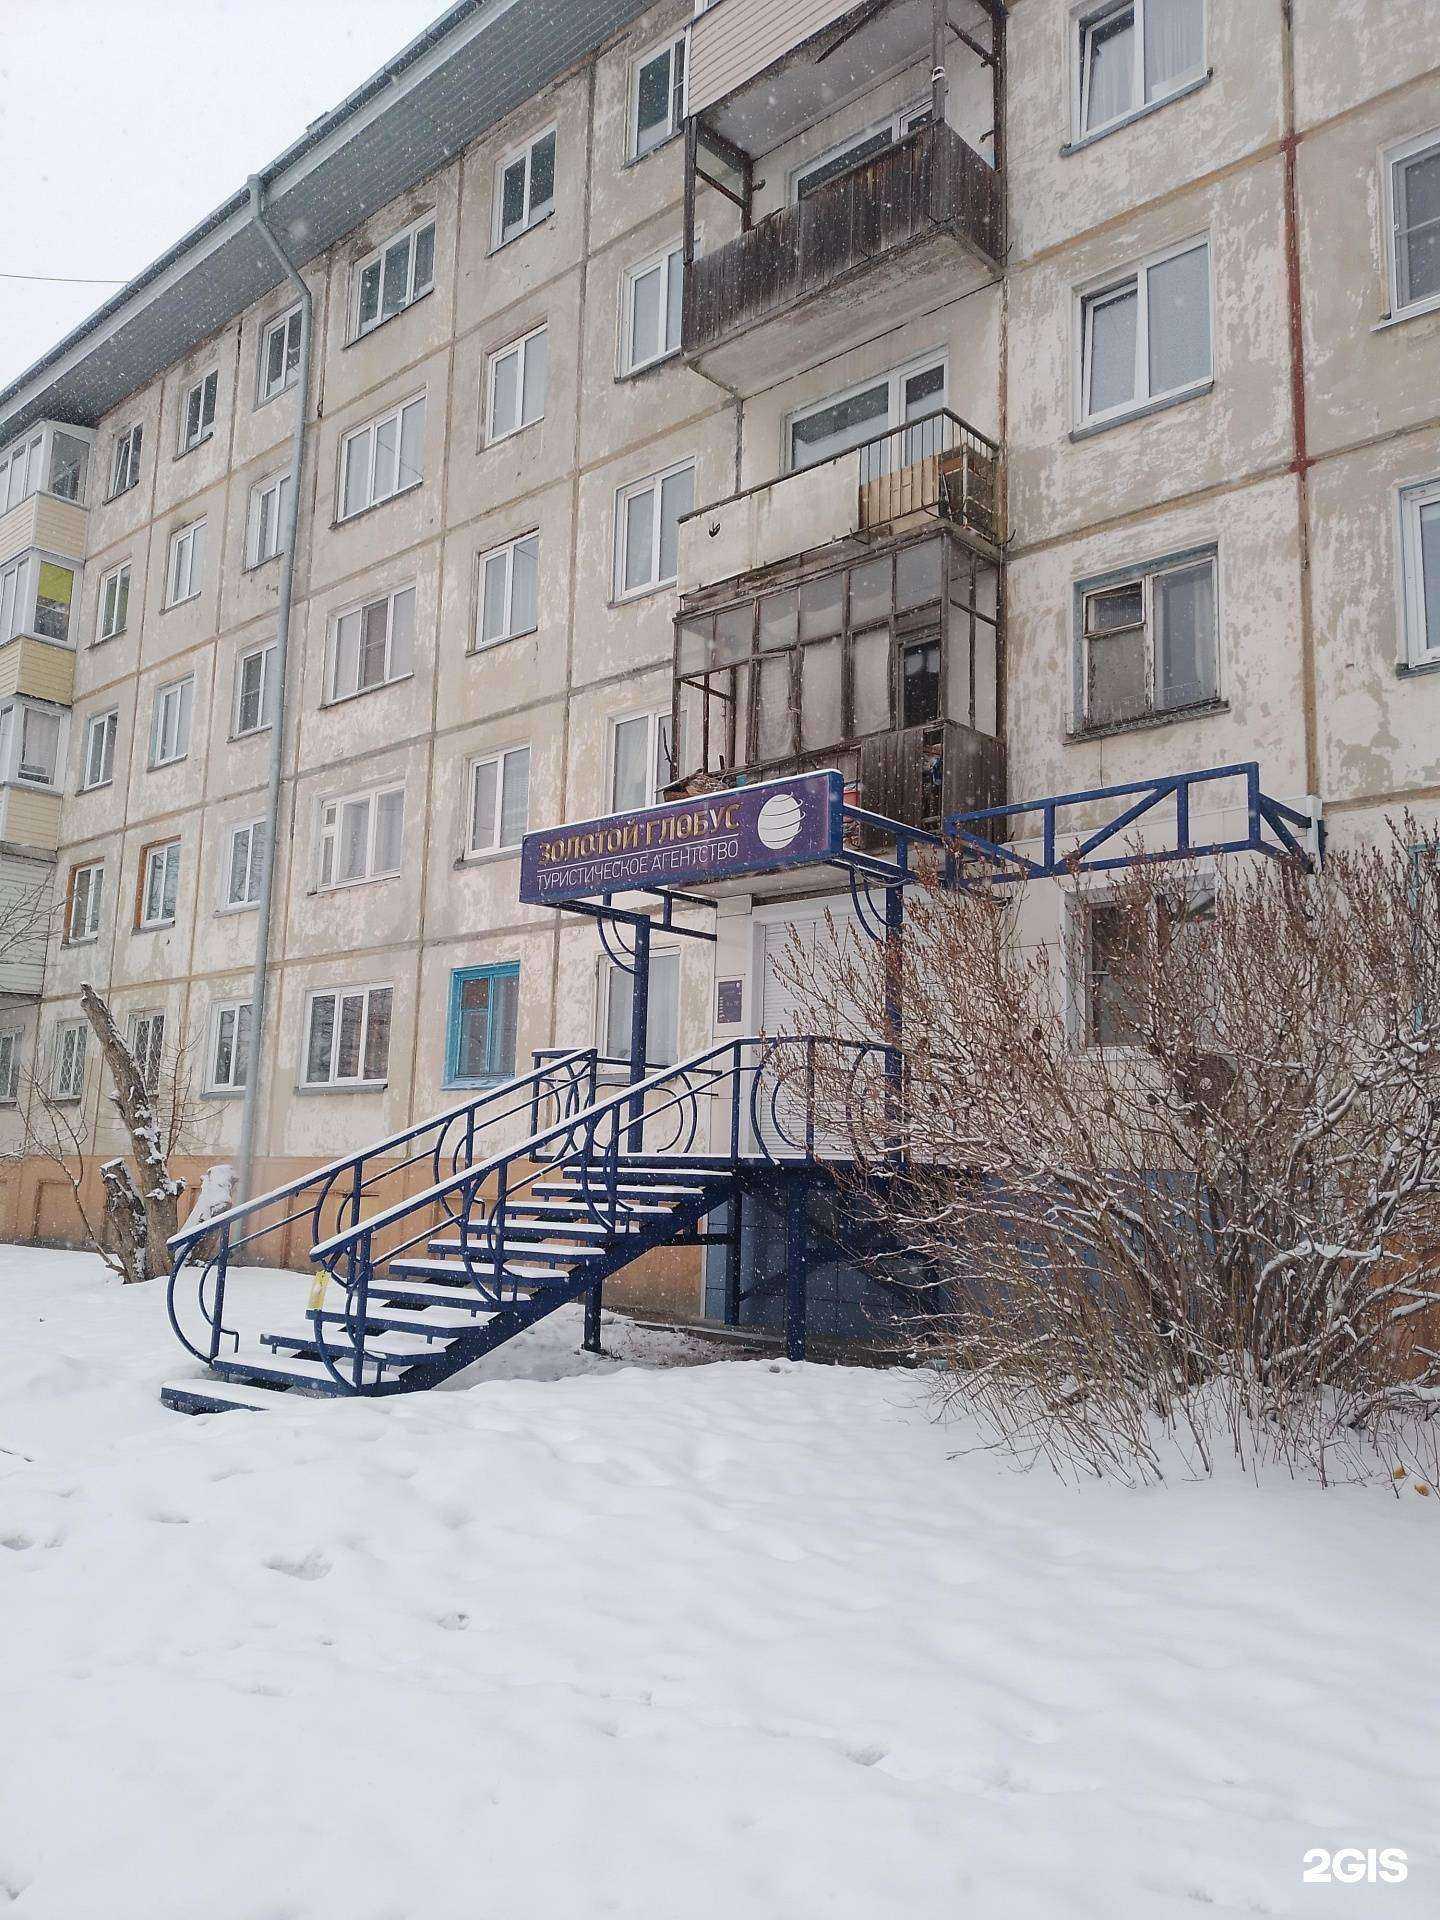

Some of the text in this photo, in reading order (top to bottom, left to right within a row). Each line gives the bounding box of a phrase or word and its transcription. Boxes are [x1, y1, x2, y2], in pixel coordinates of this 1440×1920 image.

[538, 803, 742, 863] ЗОЛОТОЙ ГЛОБУС
[537, 839, 739, 891] ТУРИСТИЧЕСКОЕ АГЕНТСТВО
